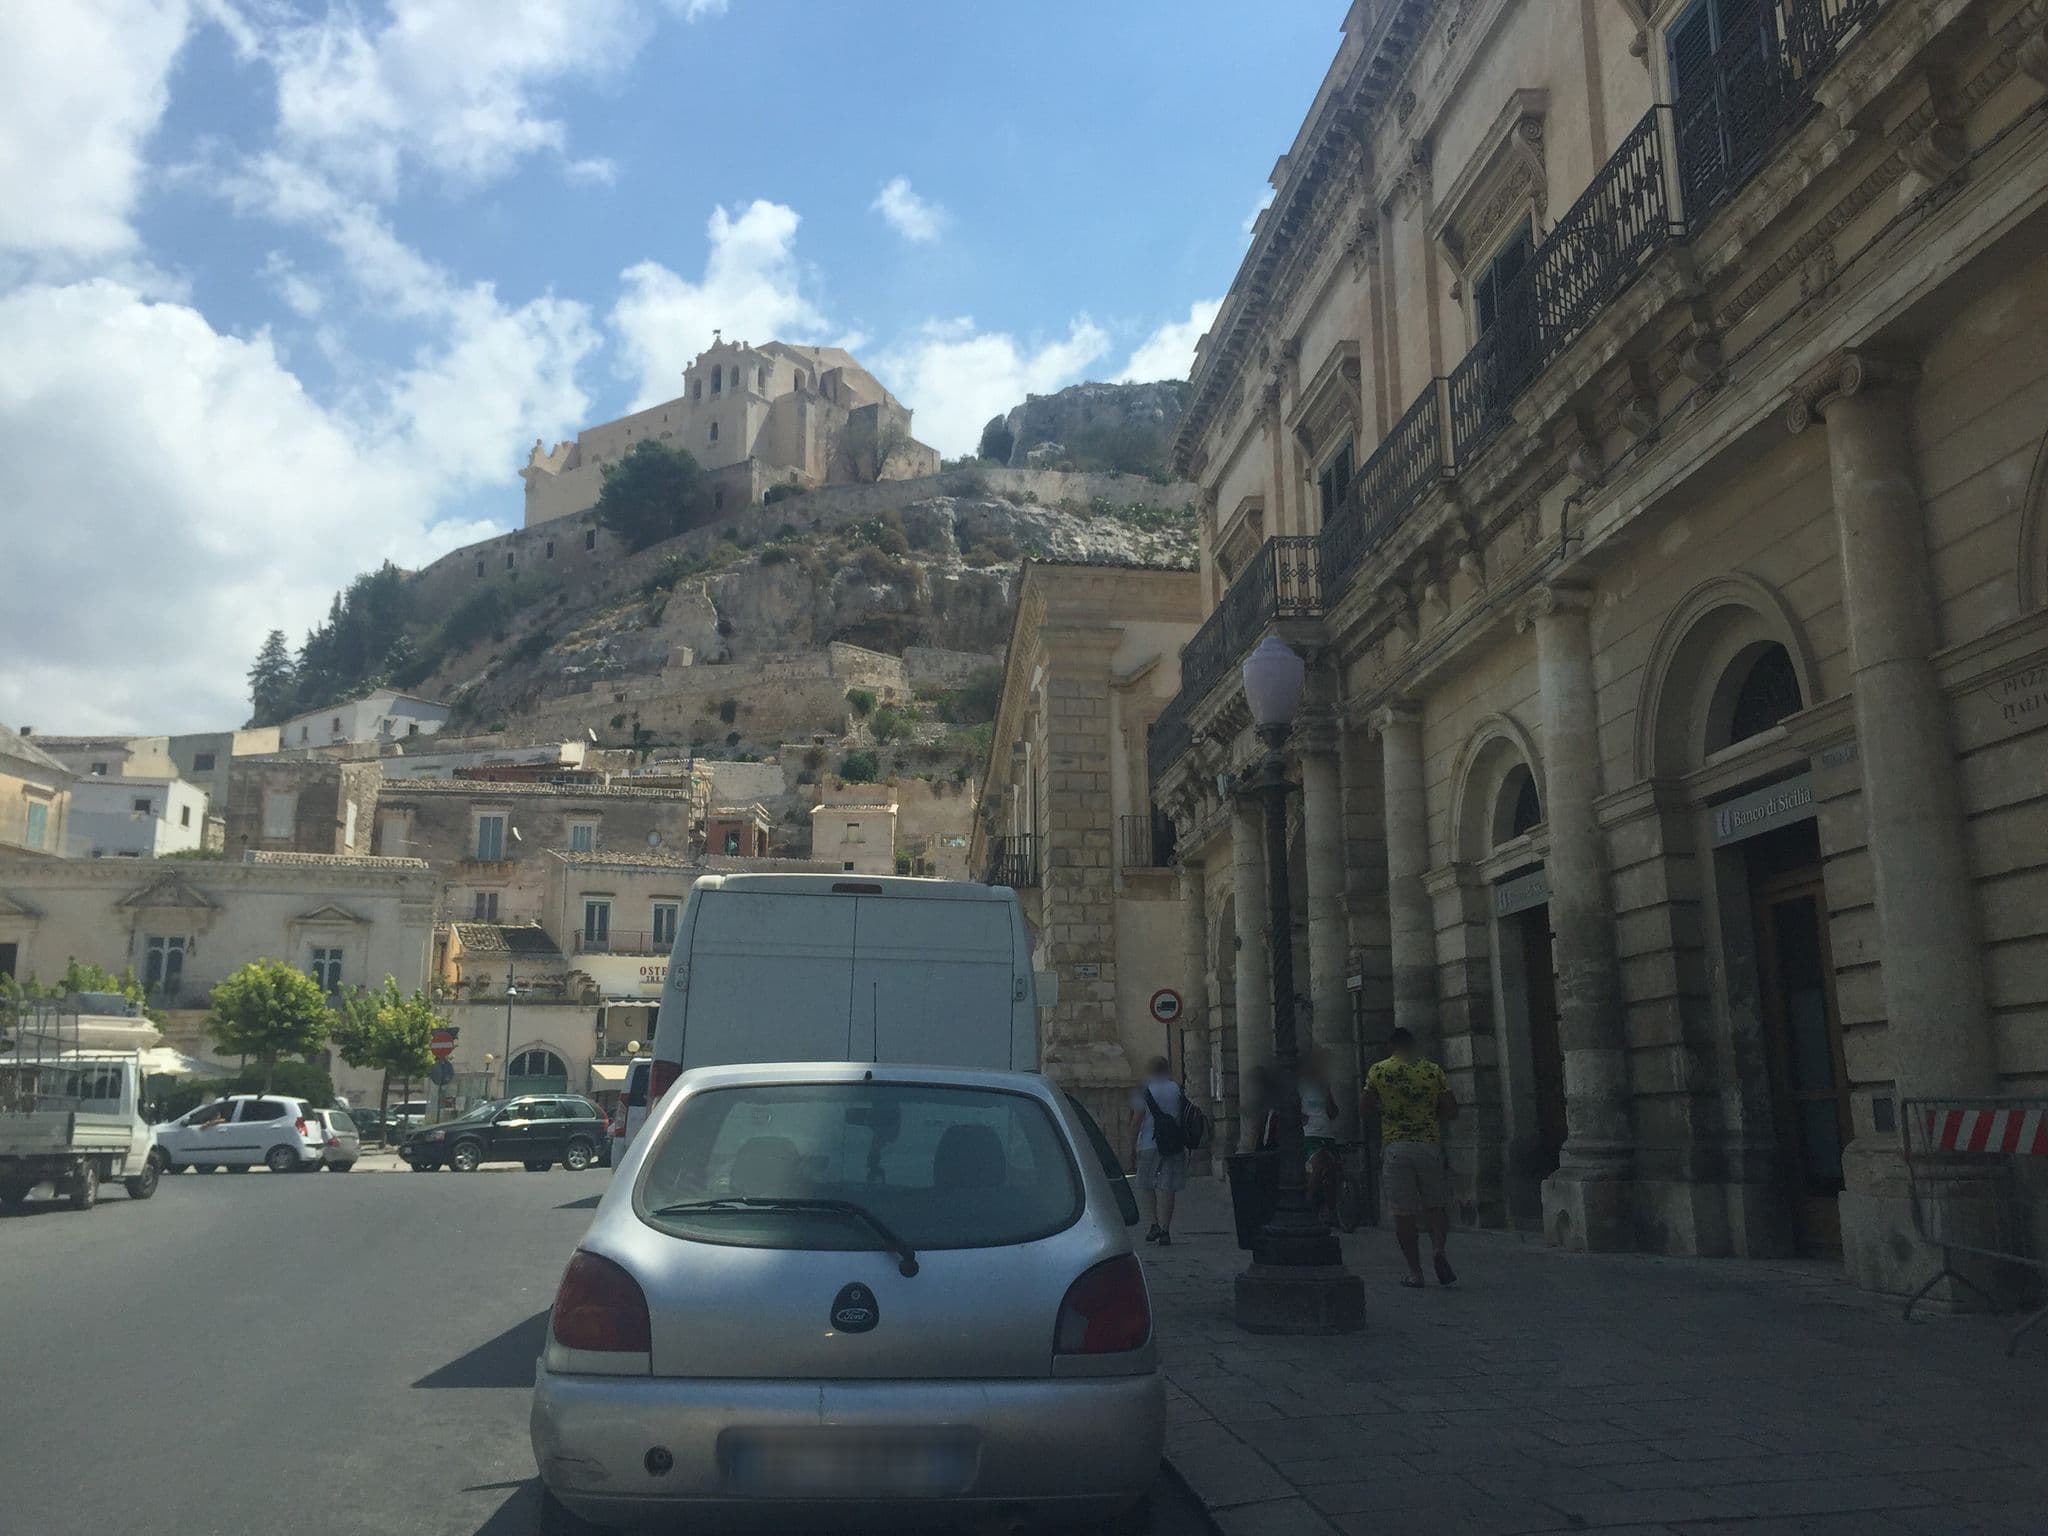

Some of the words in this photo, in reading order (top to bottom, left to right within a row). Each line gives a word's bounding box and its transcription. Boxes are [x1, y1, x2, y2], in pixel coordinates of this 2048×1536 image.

[1734, 806, 1765, 827] Banco
[1767, 799, 1777, 816] di
[1779, 787, 1811, 811] Sicilia
